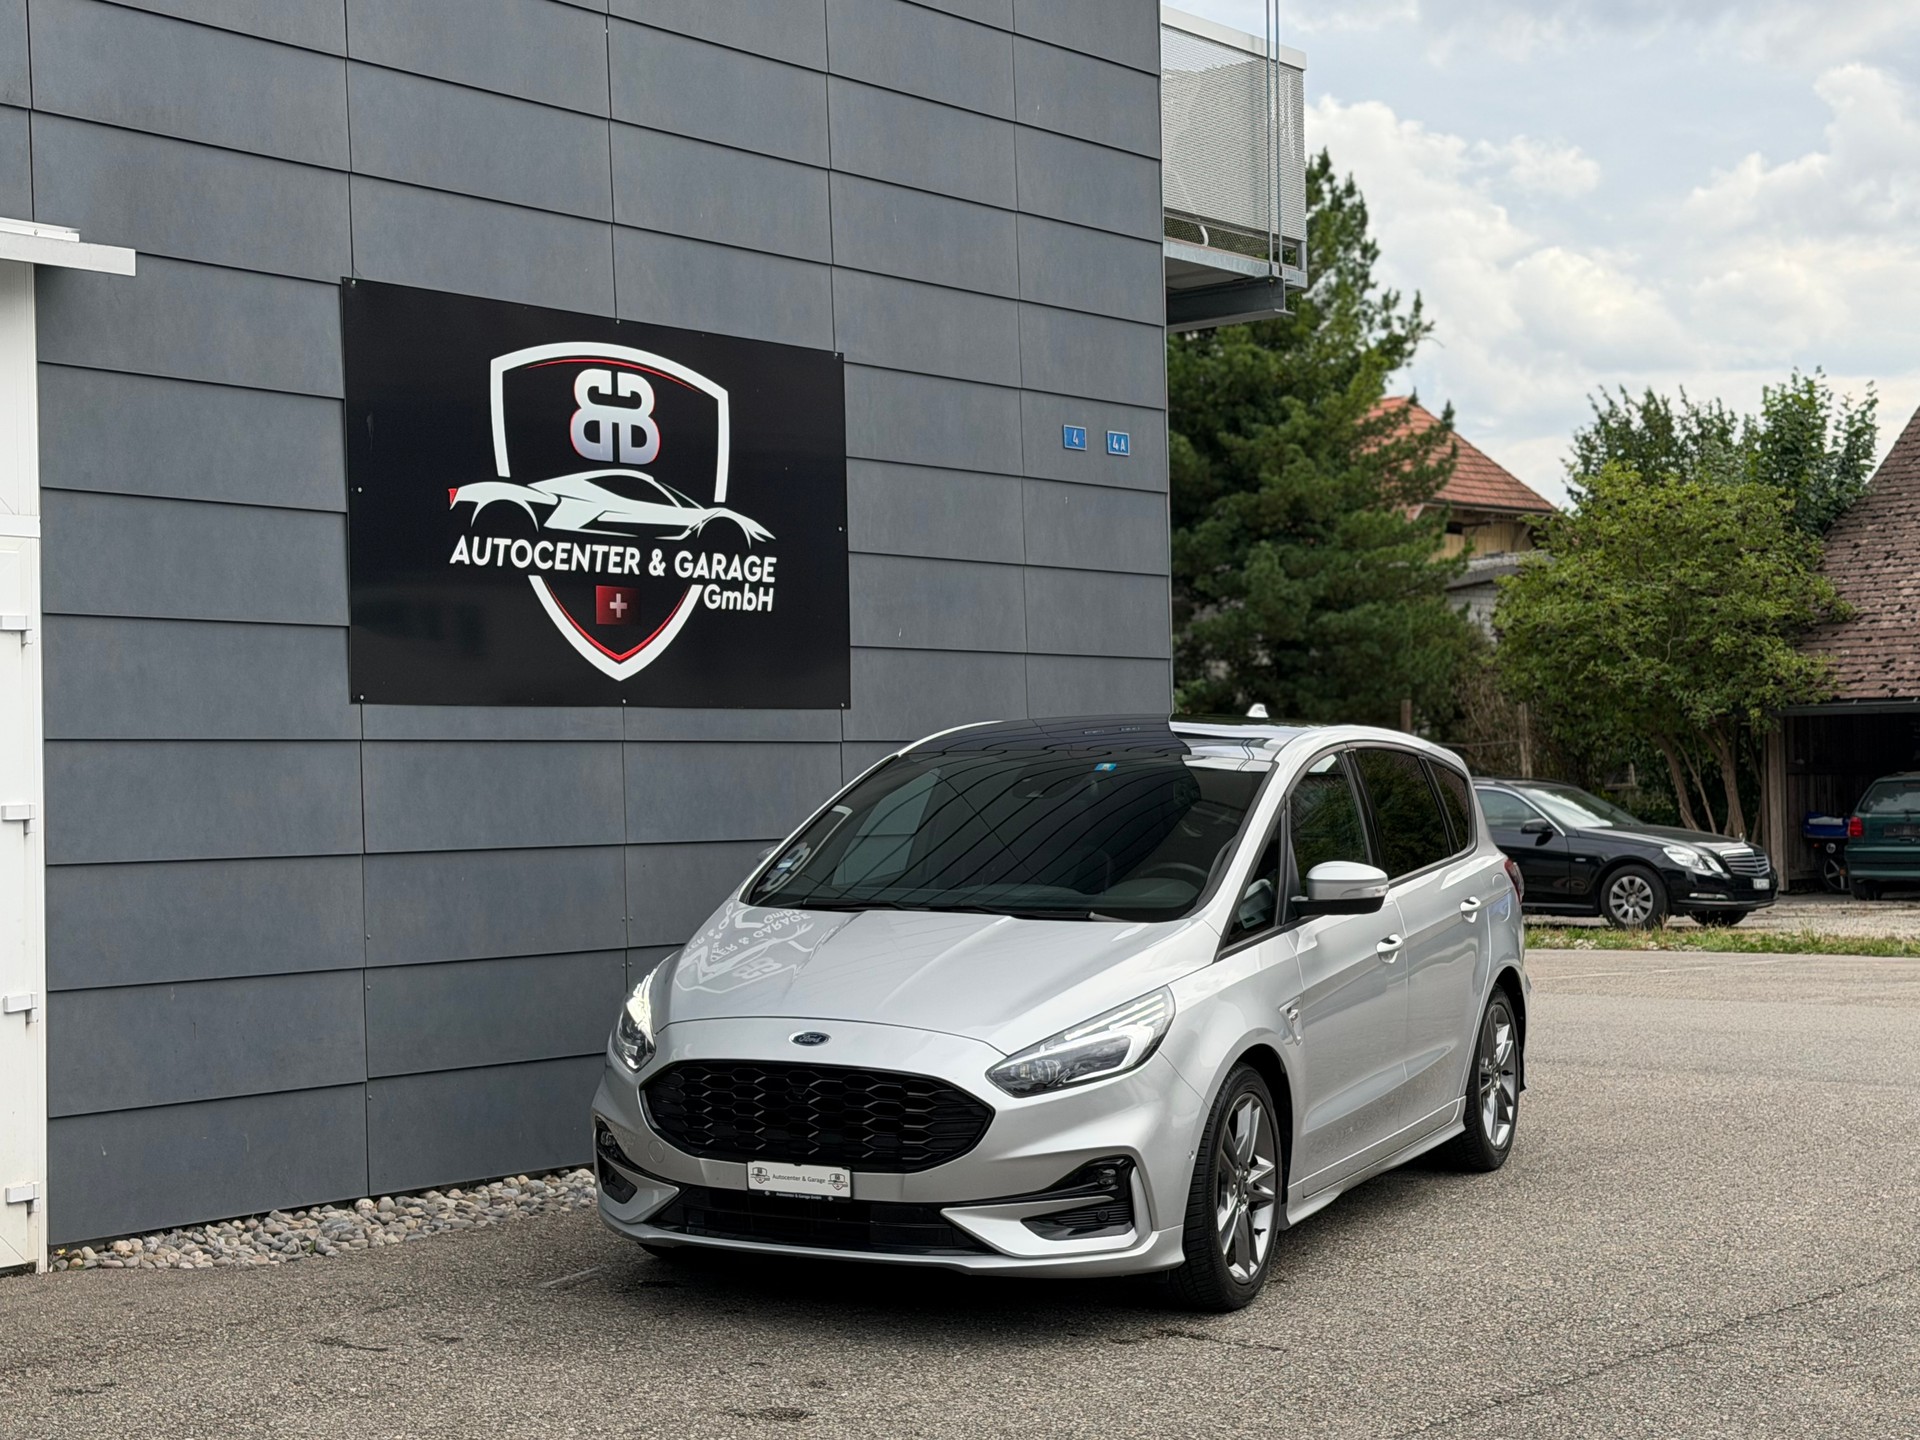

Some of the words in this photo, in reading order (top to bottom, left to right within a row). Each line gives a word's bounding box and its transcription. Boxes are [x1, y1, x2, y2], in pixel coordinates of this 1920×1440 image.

[1073, 429, 1079, 445] 4
[1113, 435, 1125, 451] 4A
[449, 535, 640, 576] AUTOCENTER
[648, 548, 665, 576] &
[674, 551, 777, 583] GARAGE
[703, 583, 774, 613] GmbH
[798, 1034, 823, 1043] Ford
[807, 1176, 826, 1184] Garage
